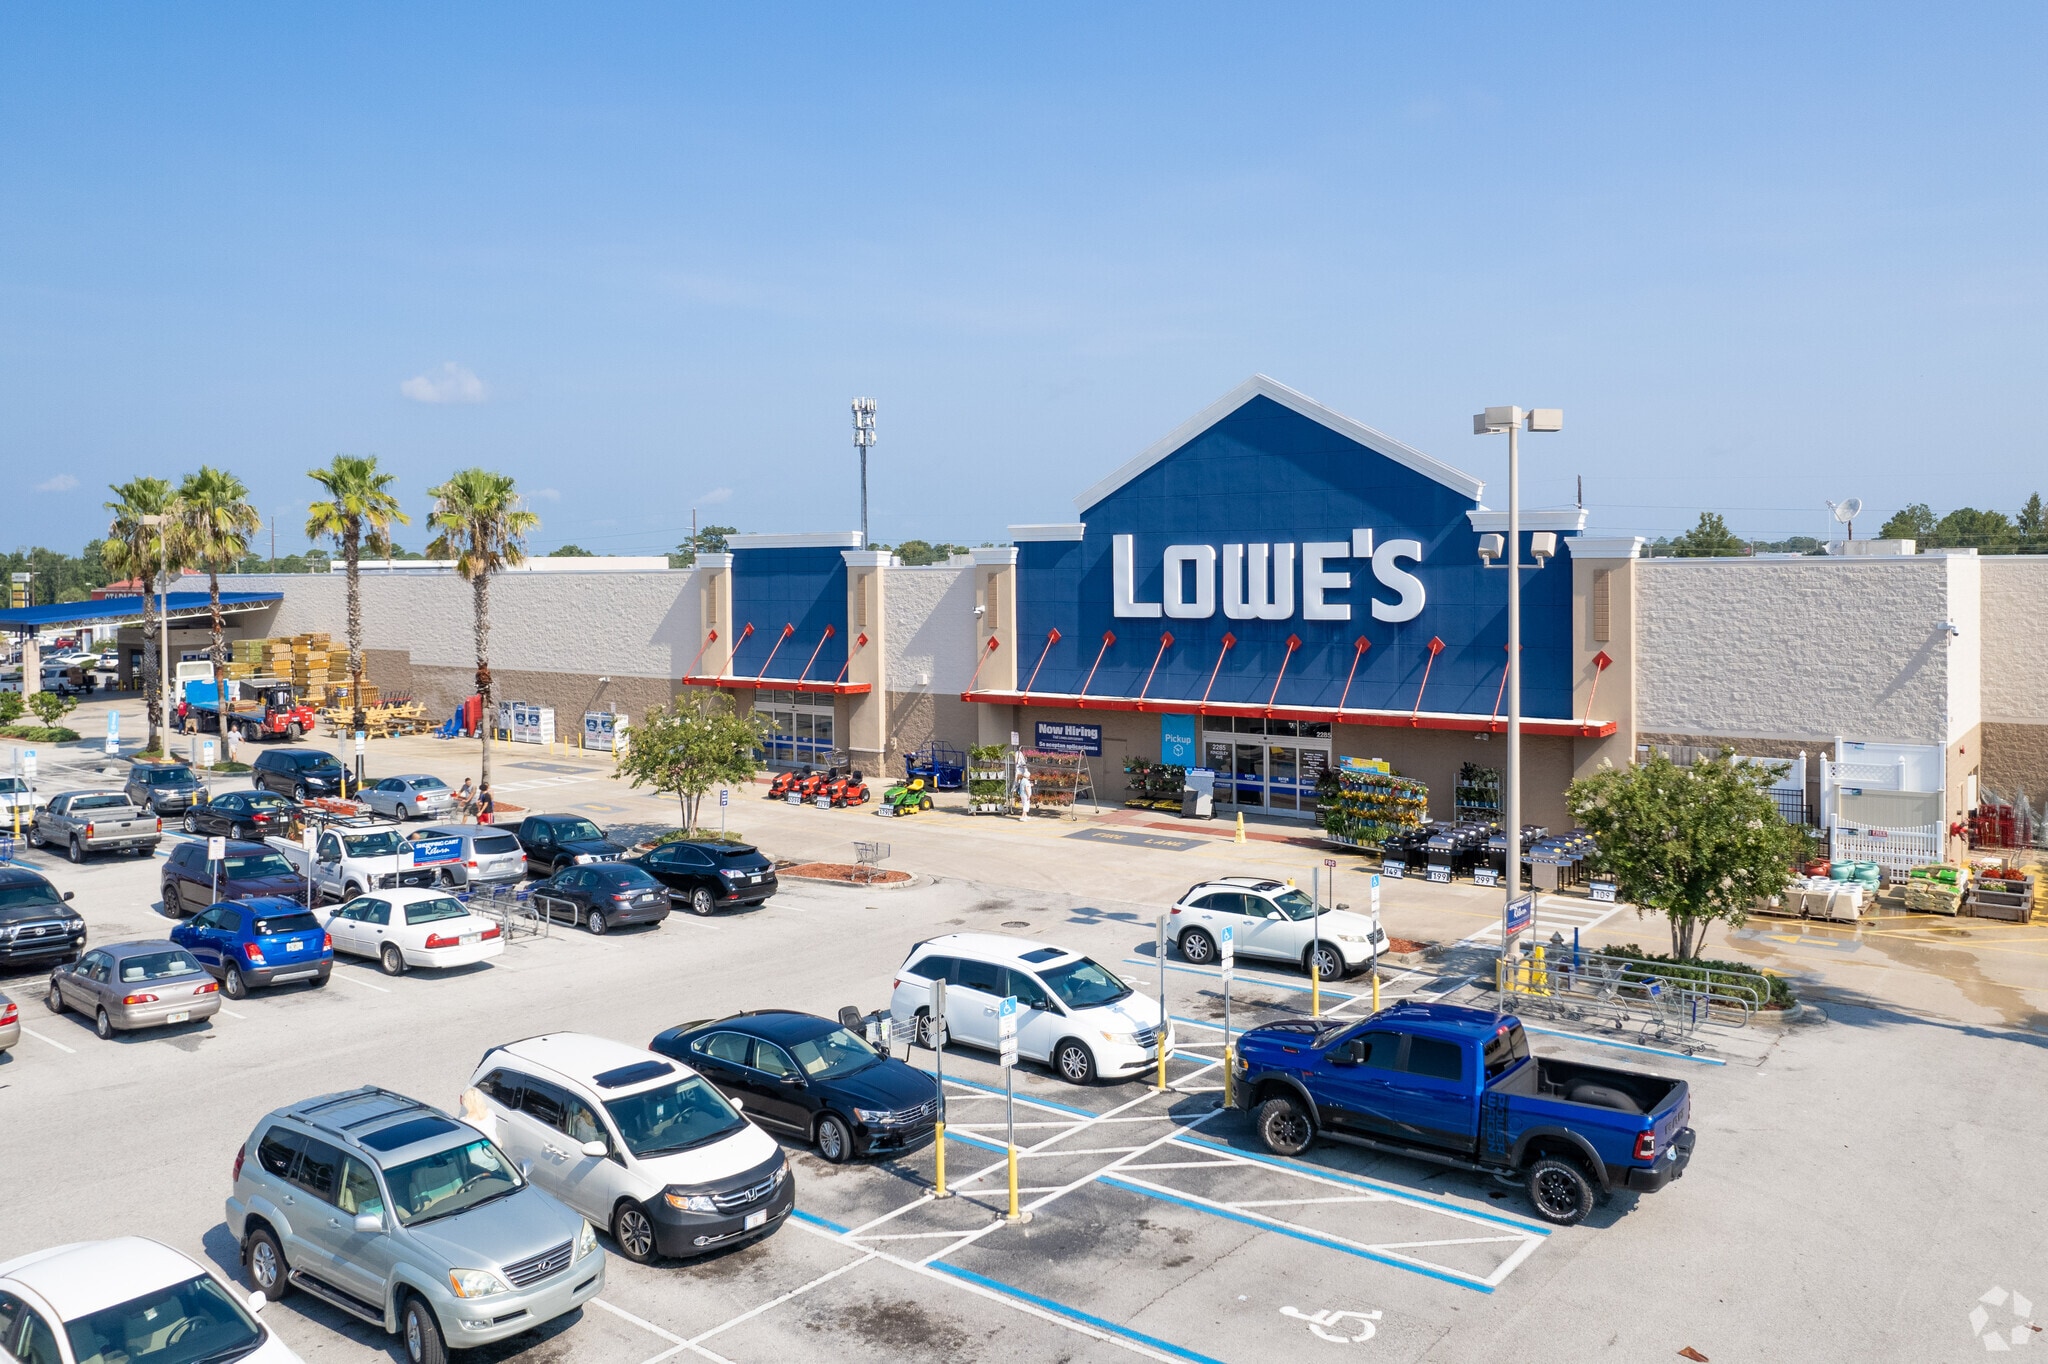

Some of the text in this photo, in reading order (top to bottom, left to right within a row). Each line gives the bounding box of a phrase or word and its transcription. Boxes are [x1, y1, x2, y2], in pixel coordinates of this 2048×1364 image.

[1113, 528, 1426, 622] LOWE'S
[1038, 723, 1064, 735] Now
[1064, 725, 1098, 740] Hiring
[1165, 734, 1192, 745] Pickup
[1143, 838, 1187, 847] LANE
[425, 846, 450, 855] Return
[1385, 867, 1398, 875] 149
[1432, 872, 1448, 881] 199
[1475, 876, 1491, 884] 299
[1595, 890, 1611, 899] 109
